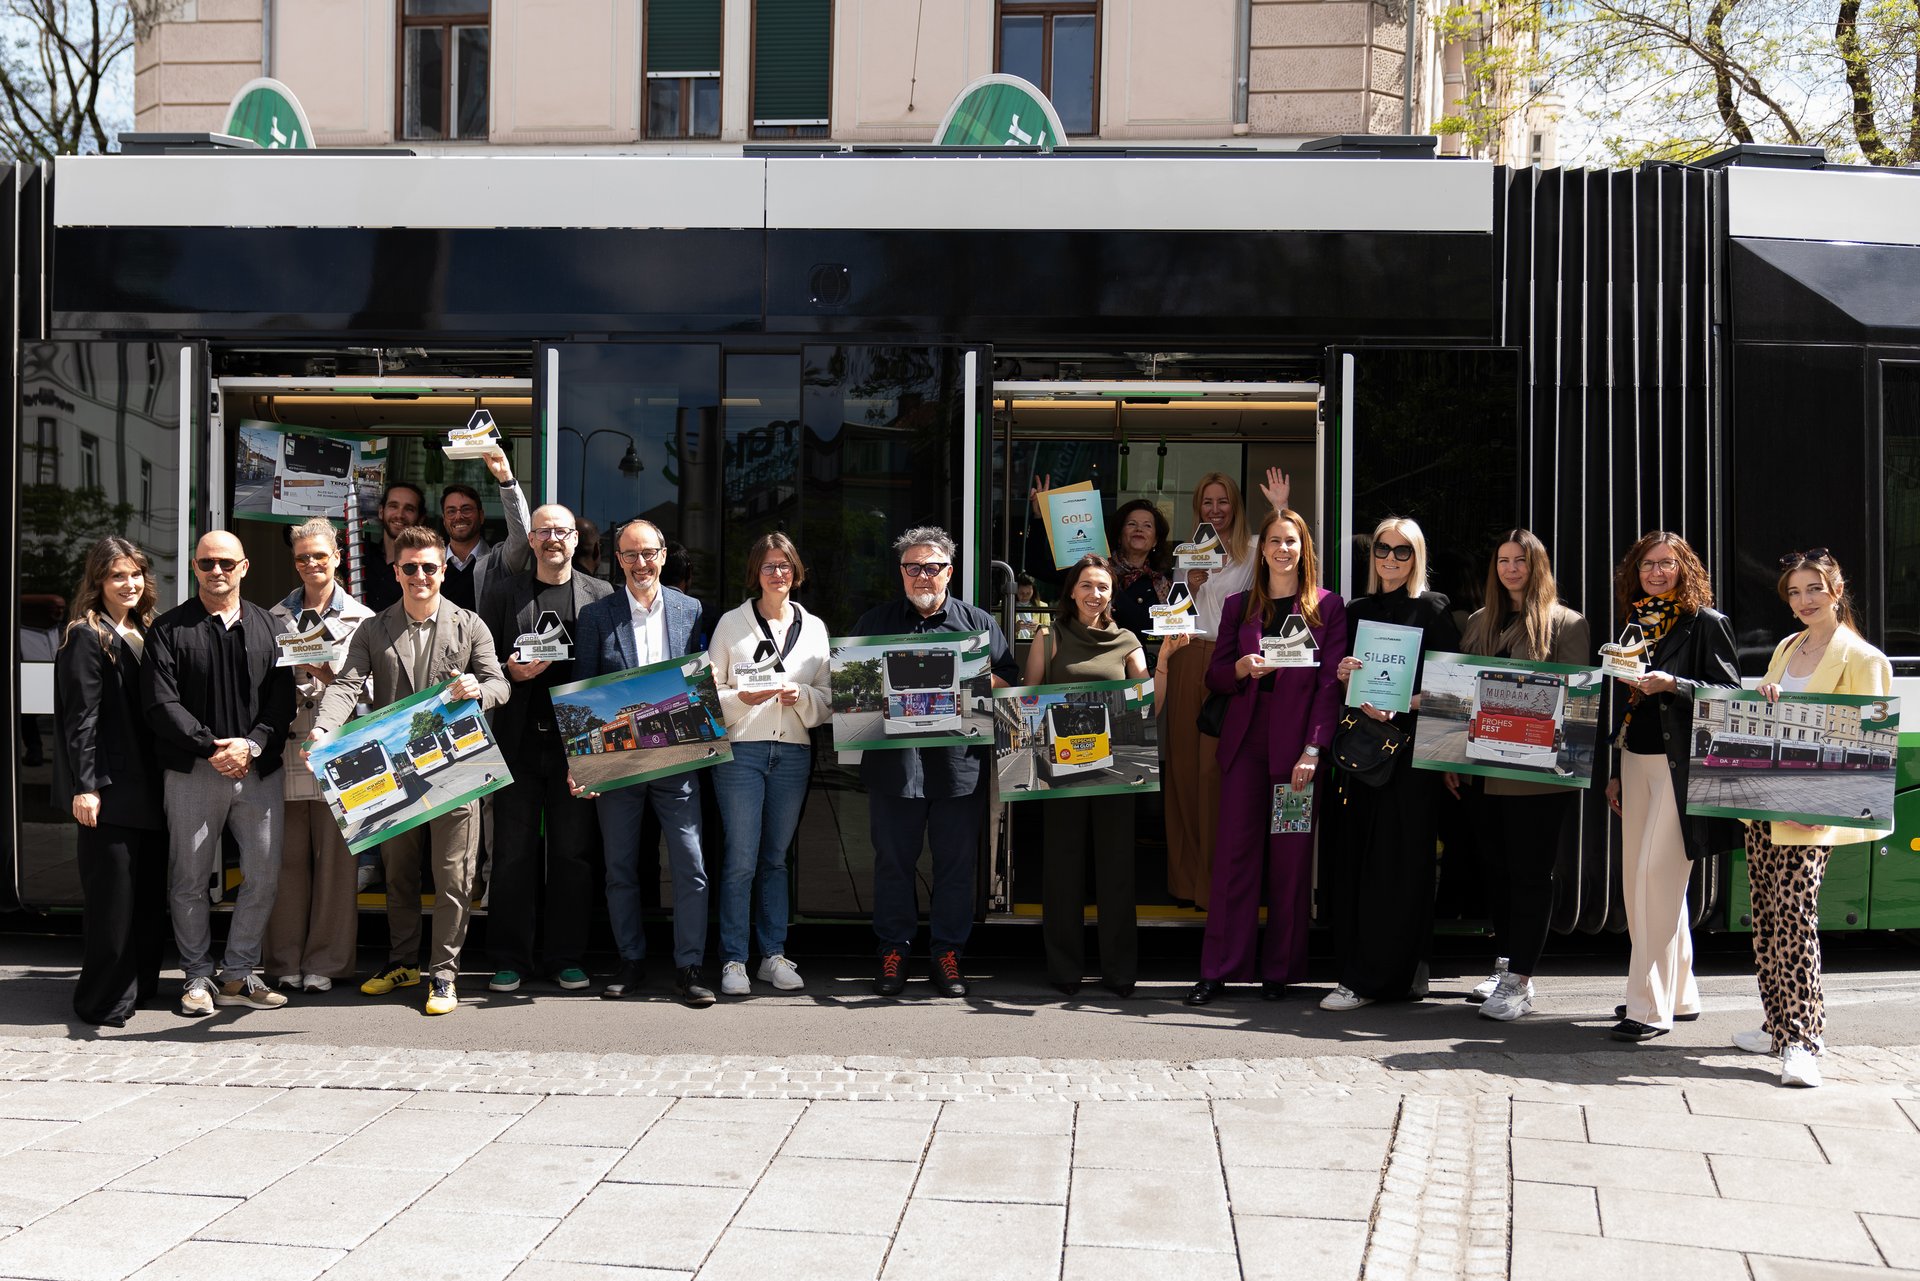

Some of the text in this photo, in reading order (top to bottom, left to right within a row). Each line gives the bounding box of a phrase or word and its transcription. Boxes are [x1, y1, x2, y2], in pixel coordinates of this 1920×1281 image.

[367, 439, 377, 454] 1
[1061, 513, 1093, 524] GOLD
[292, 643, 323, 653] BRONZE
[532, 645, 557, 653] SILBER
[968, 635, 982, 654] 2
[1364, 652, 1406, 665] SILBER
[1611, 657, 1638, 668] BRONZE
[689, 658, 705, 678] 2
[1577, 670, 1593, 690] 2
[1132, 683, 1143, 701] 1
[1486, 687, 1530, 701] MURPARK
[1871, 700, 1890, 723] 3
[1481, 725, 1501, 733] FEST
[1482, 717, 1513, 728] FROHES
